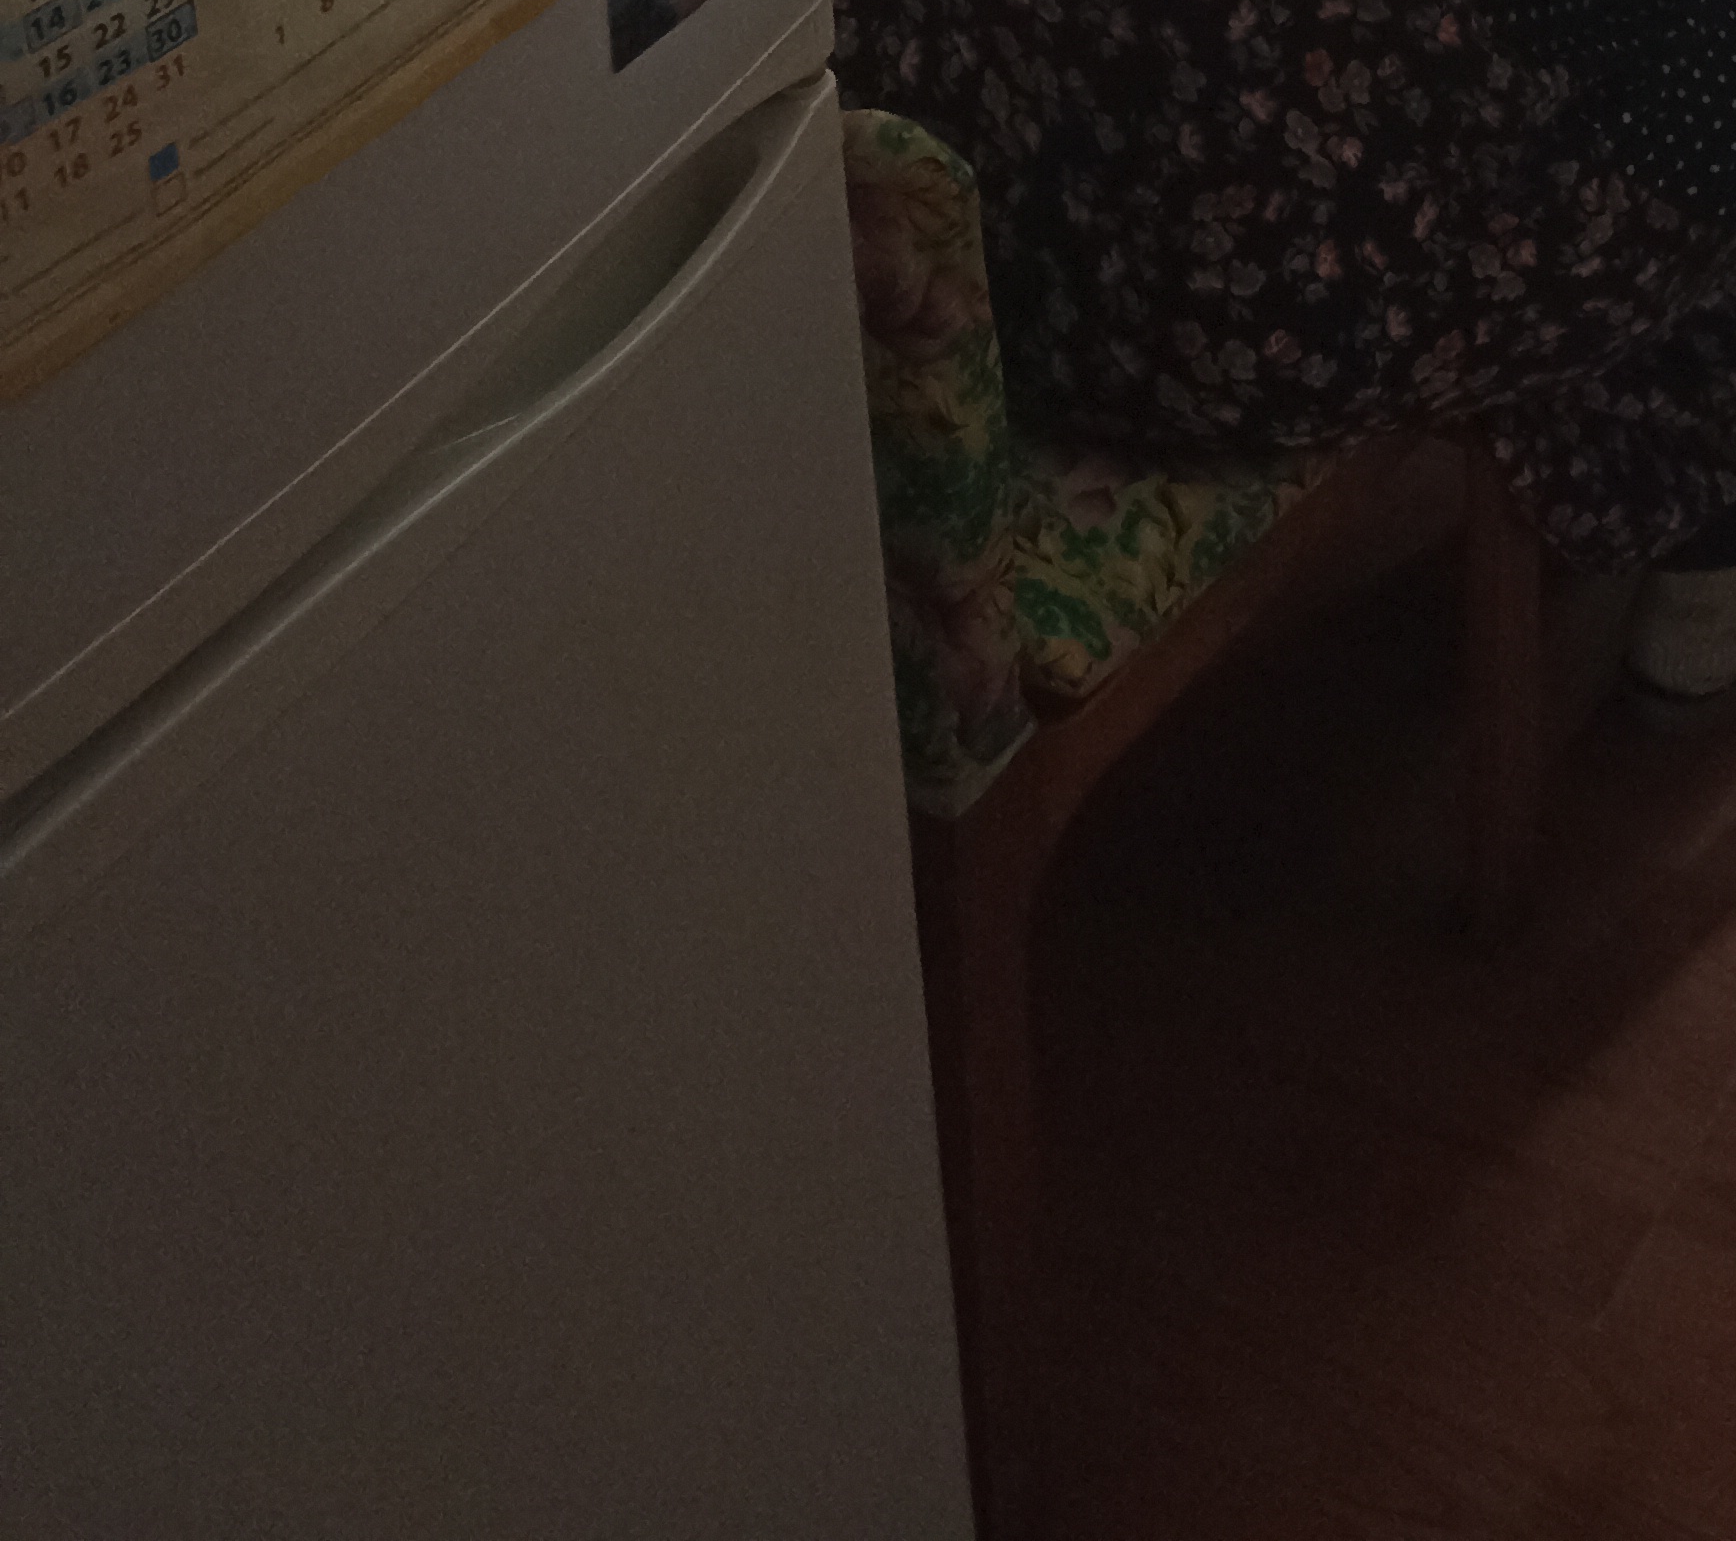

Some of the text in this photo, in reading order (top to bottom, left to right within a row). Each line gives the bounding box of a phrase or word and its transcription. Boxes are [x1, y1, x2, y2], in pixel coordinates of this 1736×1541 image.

[30, 6, 66, 41] 14
[39, 45, 72, 79] 15
[94, 13, 126, 50] 22
[43, 19, 181, 116] 16 23 30
